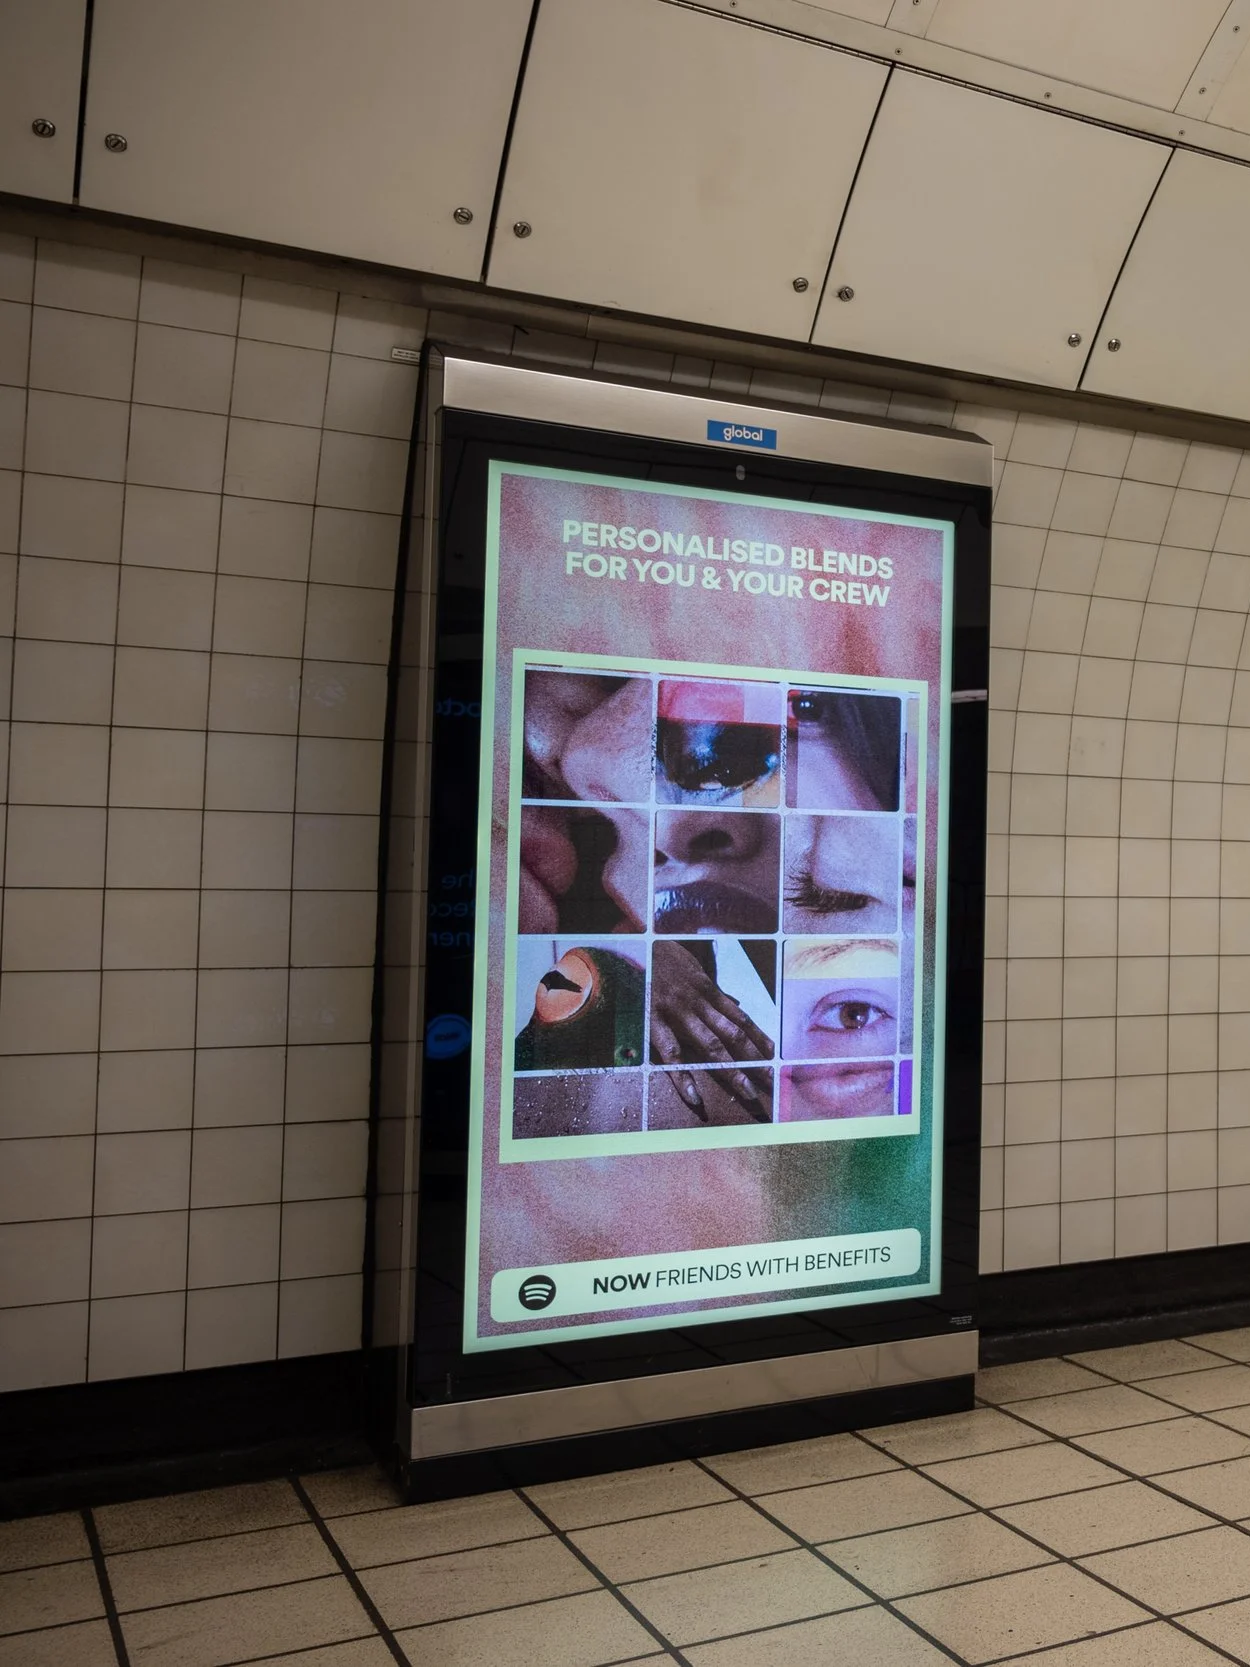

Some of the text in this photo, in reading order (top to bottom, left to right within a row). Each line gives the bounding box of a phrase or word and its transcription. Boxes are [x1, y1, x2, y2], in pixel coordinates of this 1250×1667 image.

[723, 425, 763, 441] global
[563, 519, 894, 580] PERSONALISED BLENDS
[566, 551, 891, 607] FOR YOU & YOUR CREW
[593, 1246, 891, 1294] NOW FRIENDS WITH BENEFITS
